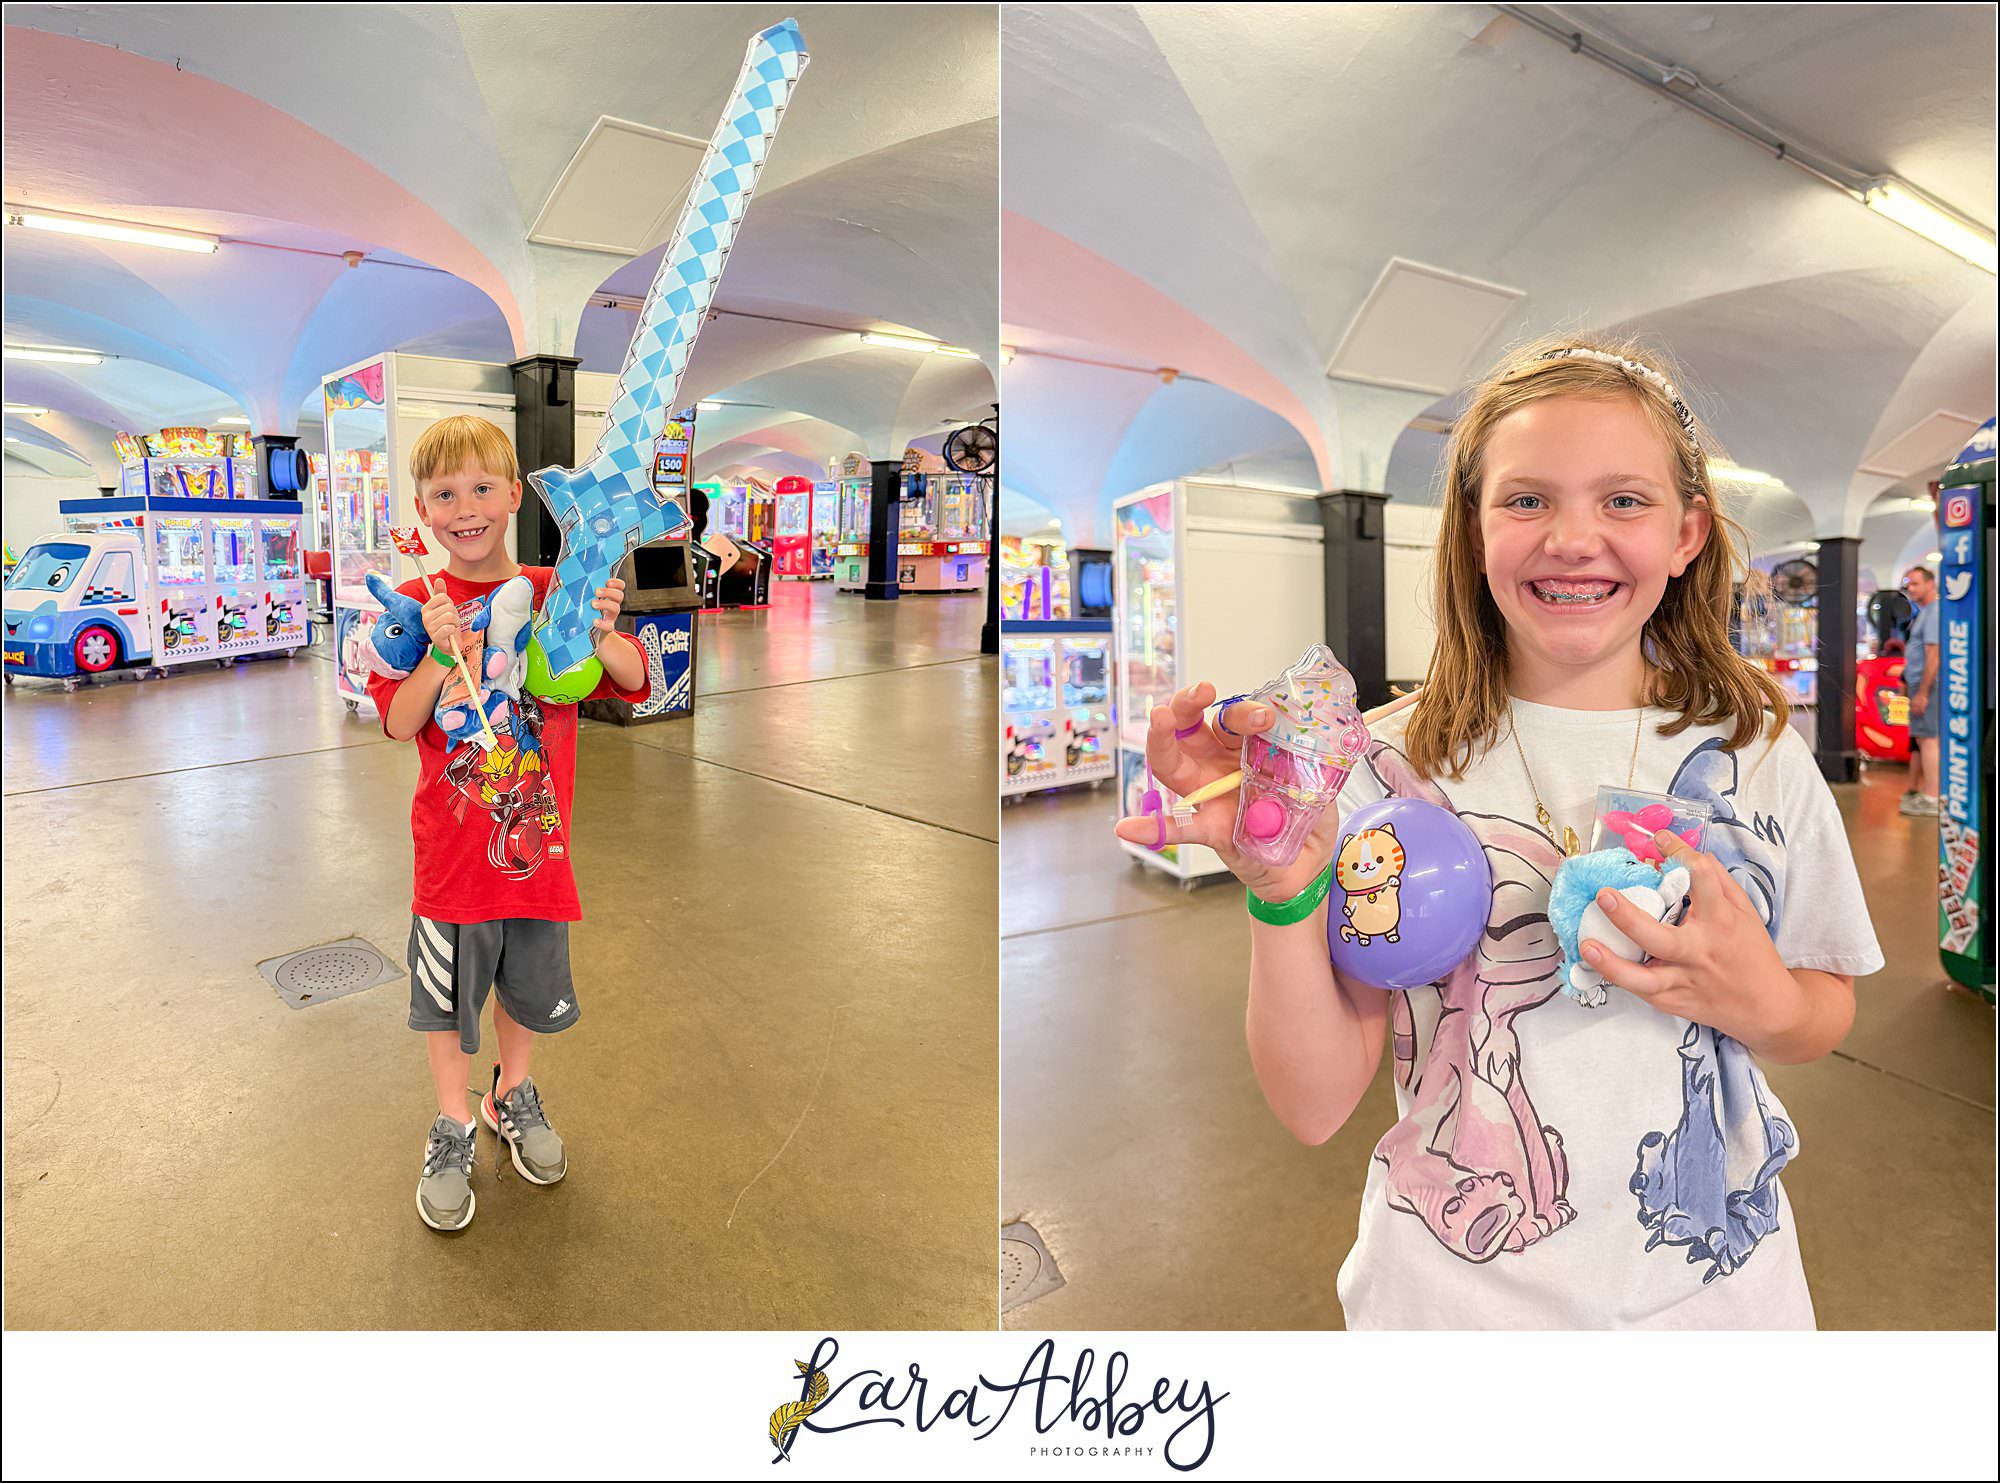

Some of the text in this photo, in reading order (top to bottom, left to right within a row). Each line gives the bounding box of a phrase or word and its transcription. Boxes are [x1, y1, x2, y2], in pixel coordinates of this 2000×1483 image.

[660, 628, 689, 643] Cedar
[661, 640, 689, 654] Point
[1949, 621, 1968, 819] PRINT & SHARE
